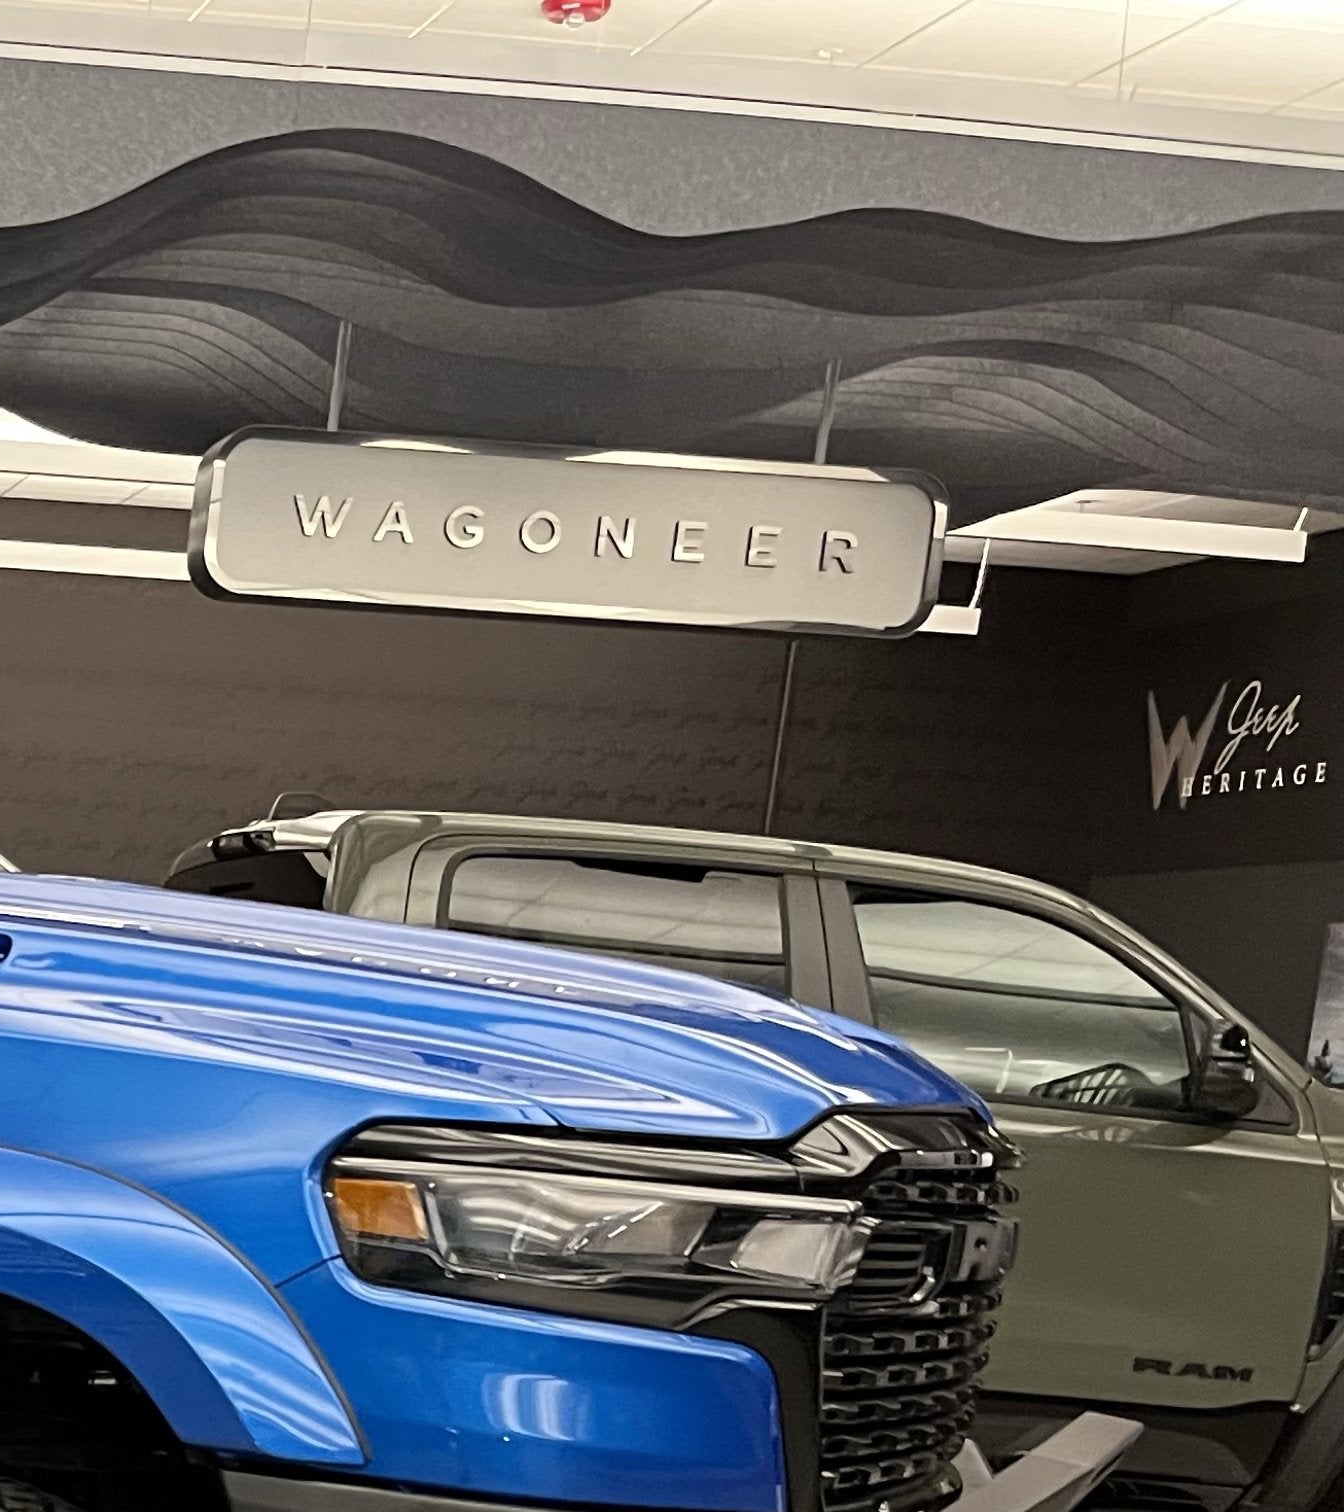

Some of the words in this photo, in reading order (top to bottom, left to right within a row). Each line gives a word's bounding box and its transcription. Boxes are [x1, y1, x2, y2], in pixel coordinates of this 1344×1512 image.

[294, 493, 861, 576] WAGONEER
[1213, 679, 1302, 776] Jeep
[1180, 761, 1327, 799] HERITAGE
[1132, 1356, 1254, 1383] RAM
